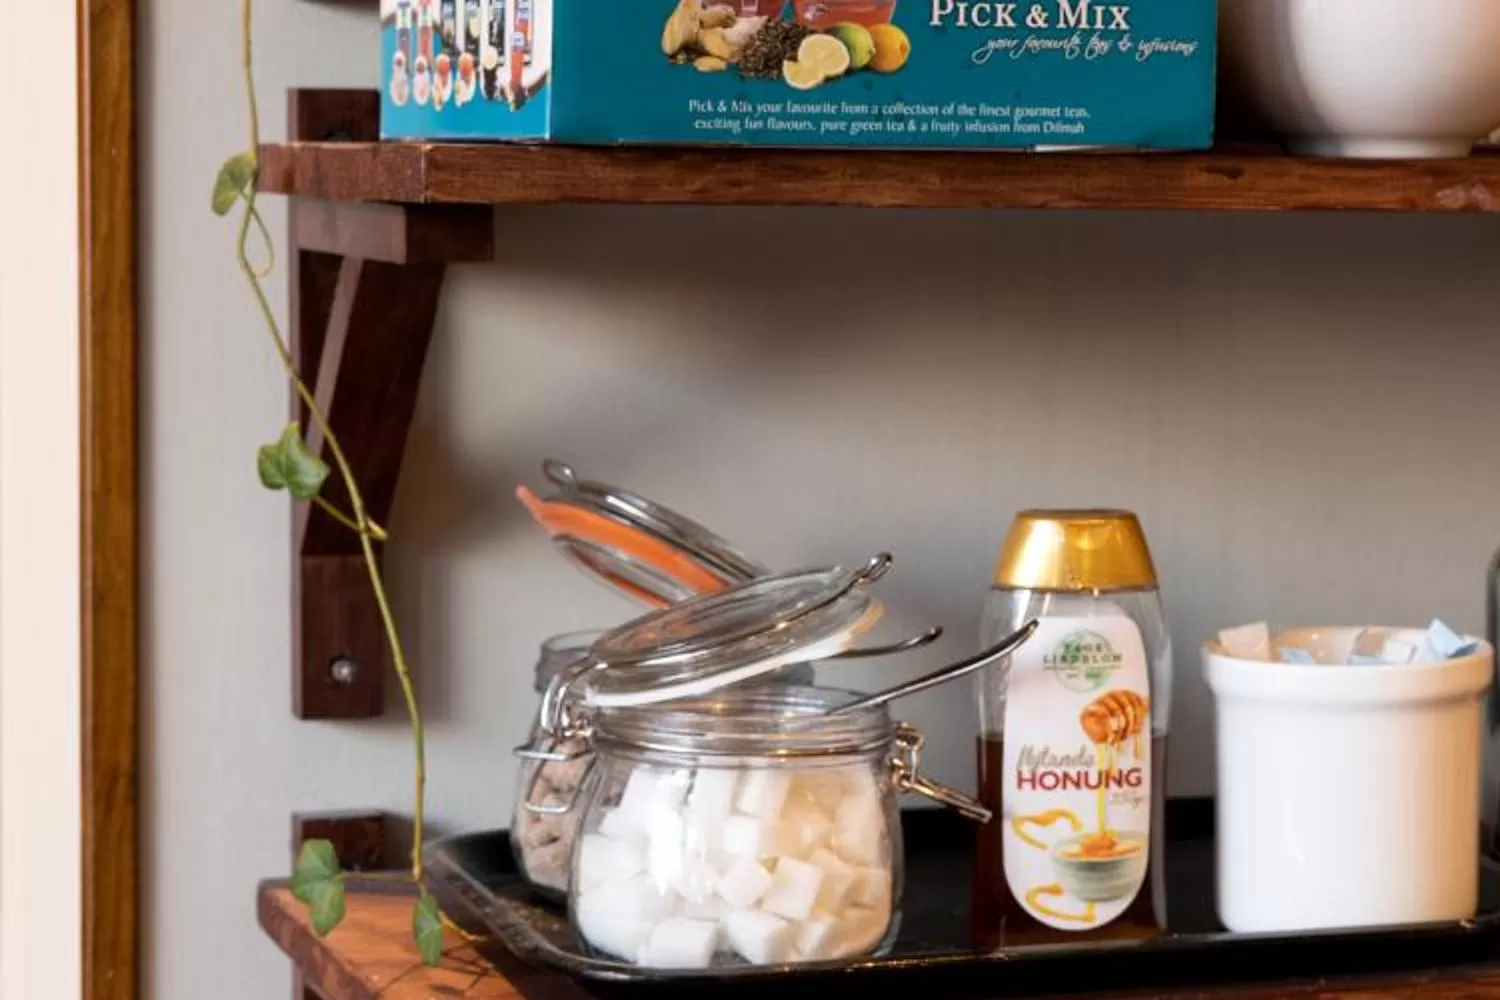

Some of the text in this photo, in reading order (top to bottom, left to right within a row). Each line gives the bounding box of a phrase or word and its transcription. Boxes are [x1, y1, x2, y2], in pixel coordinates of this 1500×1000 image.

[929, 0, 1131, 30] PICK & MIX
[688, 100, 714, 113] Pick
[717, 100, 728, 113] &
[756, 102, 784, 117] your
[787, 101, 837, 115] favourite
[840, 101, 868, 114] from
[882, 102, 938, 116] collection
[942, 102, 955, 116] of
[957, 103, 976, 116] the
[979, 103, 1010, 117] finest
[1014, 106, 1061, 122] gourmet
[694, 117, 740, 133] exciting
[820, 120, 847, 135] pure
[850, 121, 882, 135] green
[886, 119, 904, 131] tea
[907, 120, 916, 132] &
[931, 119, 960, 137] fruity
[964, 119, 1010, 133] infusion
[1013, 120, 1040, 133] from
[1016, 767, 1142, 791] HONUNG
